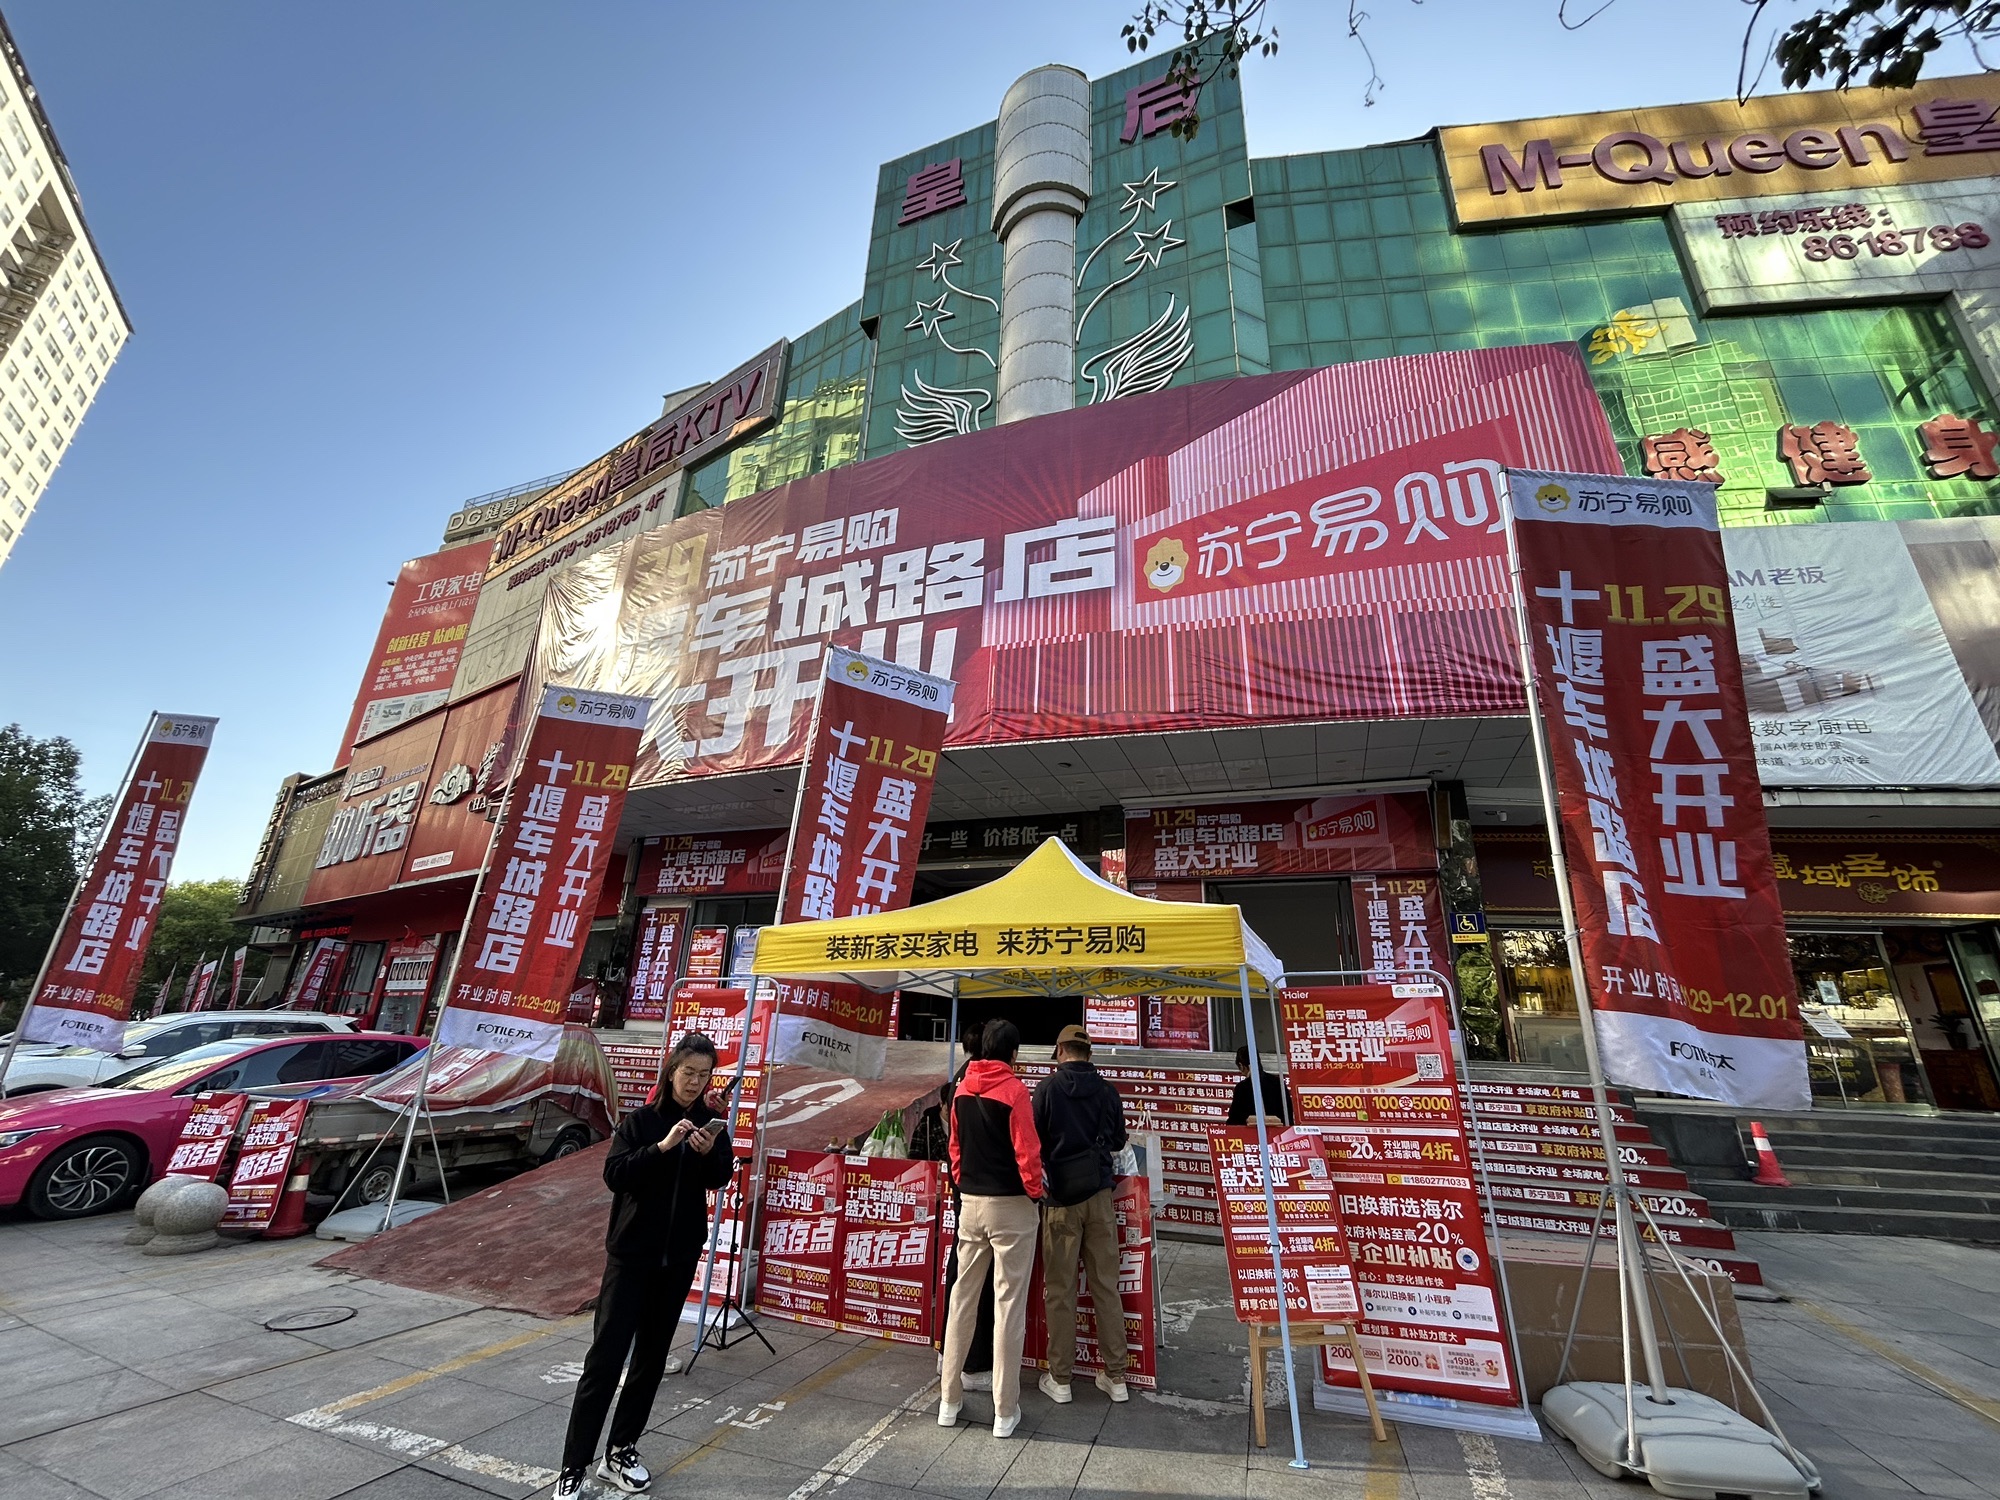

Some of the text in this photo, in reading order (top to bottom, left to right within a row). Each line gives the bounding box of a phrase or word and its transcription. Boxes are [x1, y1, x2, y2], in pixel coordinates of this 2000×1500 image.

[898, 67, 1202, 226] 皇 后
[1479, 122, 1909, 196] M-Queen
[1802, 222, 1991, 262] 8618788
[1640, 413, 2000, 487] 感 健 身
[645, 488, 667, 513] 4F
[1578, 489, 1694, 517] 苏宁易购
[1196, 457, 1511, 581] 苏宁易购
[706, 507, 900, 588] 苏宁易购
[412, 571, 483, 603] 工贸家电
[1767, 565, 1828, 586] 老板
[1603, 583, 1728, 628] 11.29
[386, 631, 431, 654] 创新经营
[870, 669, 940, 703] 苏宁易购
[578, 699, 637, 721] 苏宁易购
[865, 735, 938, 778] 11.29
[1535, 570, 1661, 945] 十堰车城路店
[1641, 634, 1747, 900] 盛大开业
[571, 760, 630, 790] 11.29
[800, 720, 867, 921] 十堰车城路
[1154, 809, 1241, 827] 11.29 苏宁易购
[1317, 810, 1377, 838] 苏宁易购
[663, 836, 692, 850] 11.29
[983, 823, 1079, 846] 价格低一点
[1154, 823, 1283, 846] 十堰车城路店
[474, 749, 573, 974] 十堰车城路店
[662, 849, 747, 867] 十堰车城路店
[1155, 843, 1258, 871] 盛大开业
[64, 771, 162, 975] 十堰车城路店
[543, 794, 610, 949] 盛大开业
[657, 865, 726, 887] 盛大开业
[1388, 880, 1427, 895] 11.29
[659, 913, 680, 923] 11.29
[825, 924, 1147, 962] 装新家买家电 来苏宁易购
[632, 911, 658, 1000] 十堰车城路店
[648, 925, 676, 1000] 盛大开业
[677, 991, 694, 999] Haier
[1282, 991, 1310, 1000] Haier
[674, 1002, 700, 1015] 11.29
[1284, 1003, 1368, 1020] 11.29 苏宁易购
[476, 1023, 534, 1040] FOTILE 方太
[672, 1016, 746, 1031] 十堰车城路店
[1287, 1021, 1408, 1039] 十堰车城路店
[669, 1030, 730, 1050] 盛开业
[801, 1031, 836, 1050] FOTILE
[836, 1041, 852, 1054] 方太
[1289, 1038, 1387, 1062] 盛大开业
[1120, 1069, 1223, 1082] 全场家电4折起 11.29苏宁易购
[1158, 1086, 1234, 1098] 湖北省家电以旧换
[1517, 1085, 1580, 1099] 全场家电4折起
[1175, 1104, 1222, 1115] 11.29苏宁易购
[1379, 1111, 1448, 1119] 购物加送电火锅一台
[1488, 1104, 1519, 1113] 苏宁易购
[1525, 1104, 1585, 1119] 享政府补贴
[182, 1123, 217, 1136] 盛大开业
[245, 1131, 279, 1146] 盛大开业
[166, 1139, 228, 1171] 预存点
[1214, 1138, 1243, 1151] 11.29
[1351, 1142, 1384, 1160] 20%
[1383, 1140, 1420, 1150] 开业期间
[1384, 1149, 1421, 1160] 全场家电
[1500, 1142, 1648, 1165] 苏宁易购 享政府补贴 20%
[232, 1146, 292, 1184] 预存点
[769, 1164, 789, 1177] 11.29
[768, 1178, 827, 1196] 十堰车城路店
[847, 1172, 871, 1186] 11.29
[1410, 1177, 1467, 1187] 18602771033
[766, 1191, 814, 1211] 盛大开业
[846, 1187, 917, 1205] 十堰车城路店
[1339, 1193, 1464, 1219] 旧换新选海尔
[1528, 1189, 1698, 1218] 苏宁易购 20%
[845, 1199, 902, 1222] 盛大开业
[762, 1217, 837, 1255] 预存点
[843, 1227, 930, 1269] 预存点
